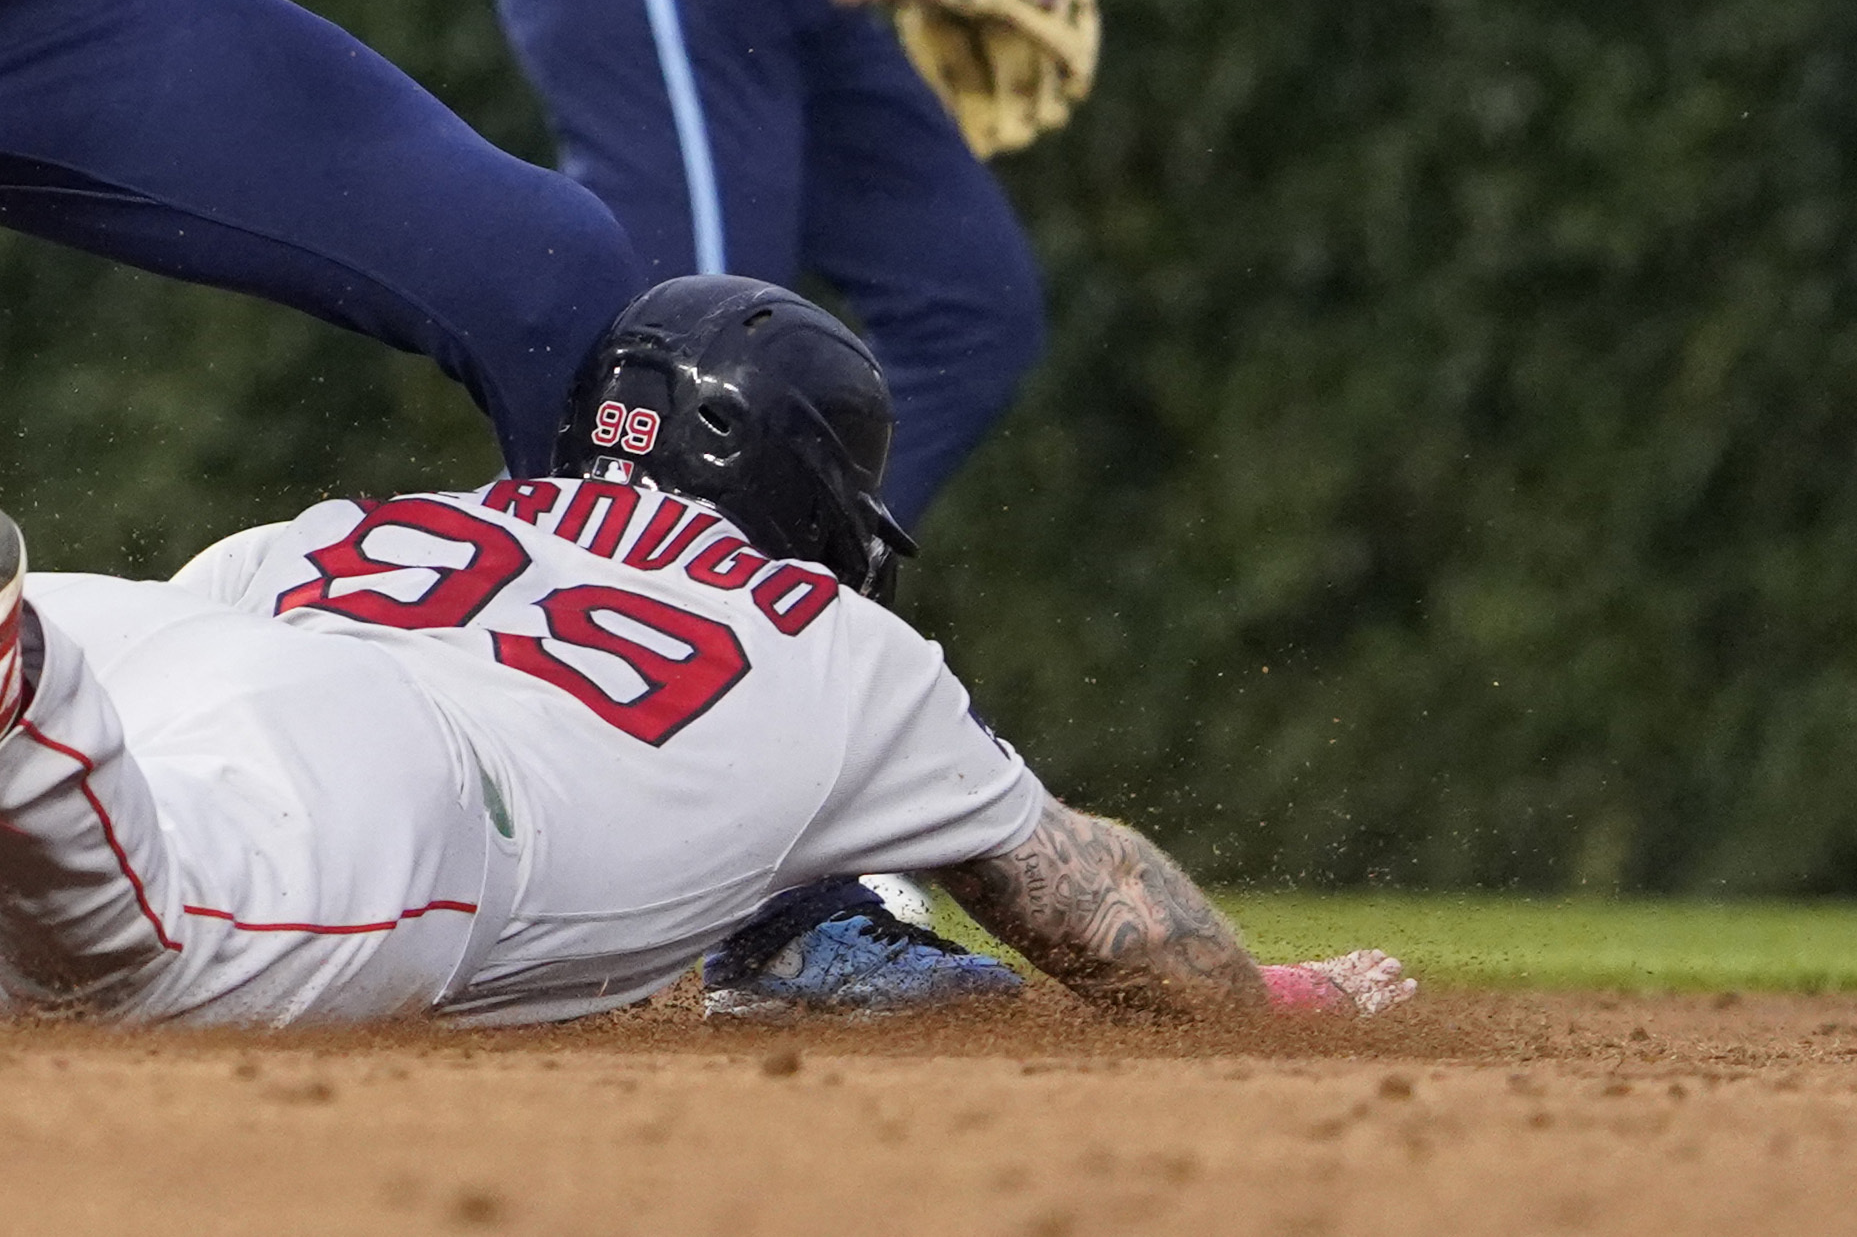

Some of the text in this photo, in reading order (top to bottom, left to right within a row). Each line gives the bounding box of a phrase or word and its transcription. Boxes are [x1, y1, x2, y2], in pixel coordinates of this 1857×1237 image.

[591, 400, 661, 455] 99
[273, 497, 752, 748] 99
[480, 478, 840, 638] RDUGO
